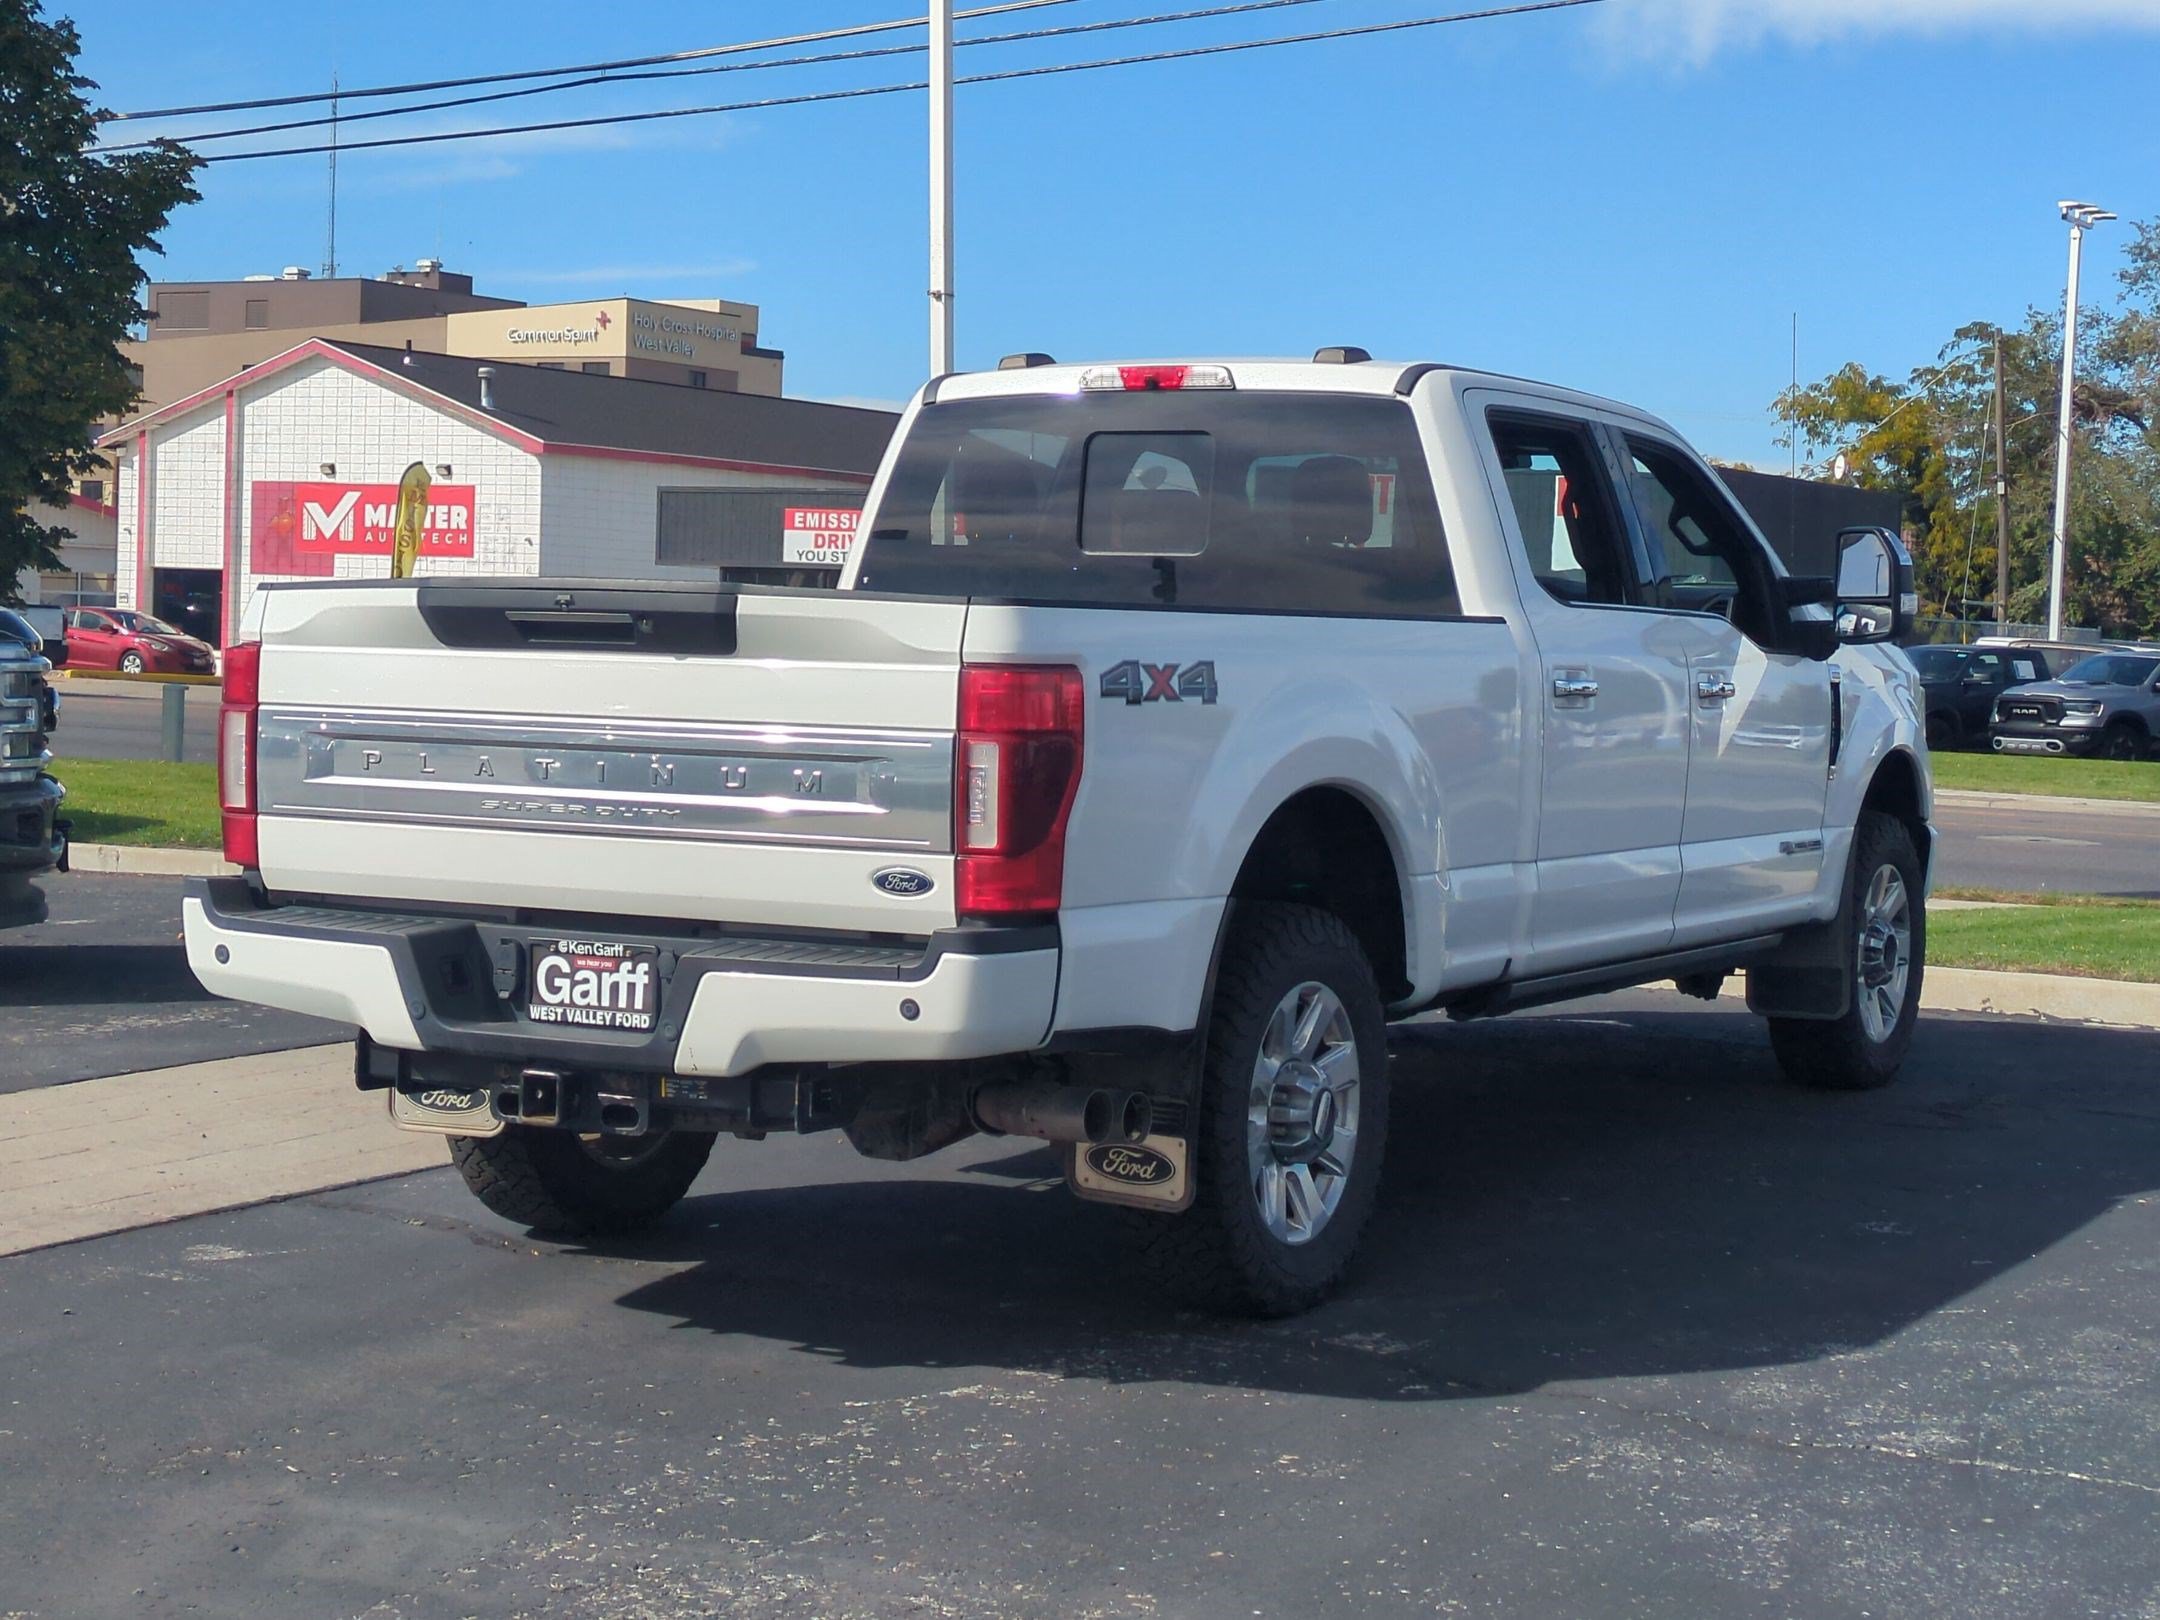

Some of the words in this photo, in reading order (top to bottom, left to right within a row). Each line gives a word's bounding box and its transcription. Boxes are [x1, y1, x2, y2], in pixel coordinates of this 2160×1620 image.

[507, 325, 599, 346] CommonSpirit
[634, 312, 658, 330] Holy
[662, 316, 693, 335] Cross
[696, 319, 738, 342] Hospital
[633, 334, 665, 351] West
[665, 337, 696, 358] Valley
[797, 550, 827, 562] YOU
[362, 749, 822, 792] PLATINUM
[481, 800, 588, 815] SUPER
[594, 805, 681, 820] DUTY
[884, 873, 918, 891] Ford
[568, 940, 593, 955] Ken
[594, 942, 624, 957] Garff
[601, 961, 613, 969] you
[536, 955, 649, 1010] Garff
[529, 1005, 564, 1022] WEST
[566, 1009, 615, 1026] VALLEY
[615, 1013, 650, 1029] FORD
[421, 1089, 472, 1109] Ford
[1103, 1148, 1157, 1179] Ford
